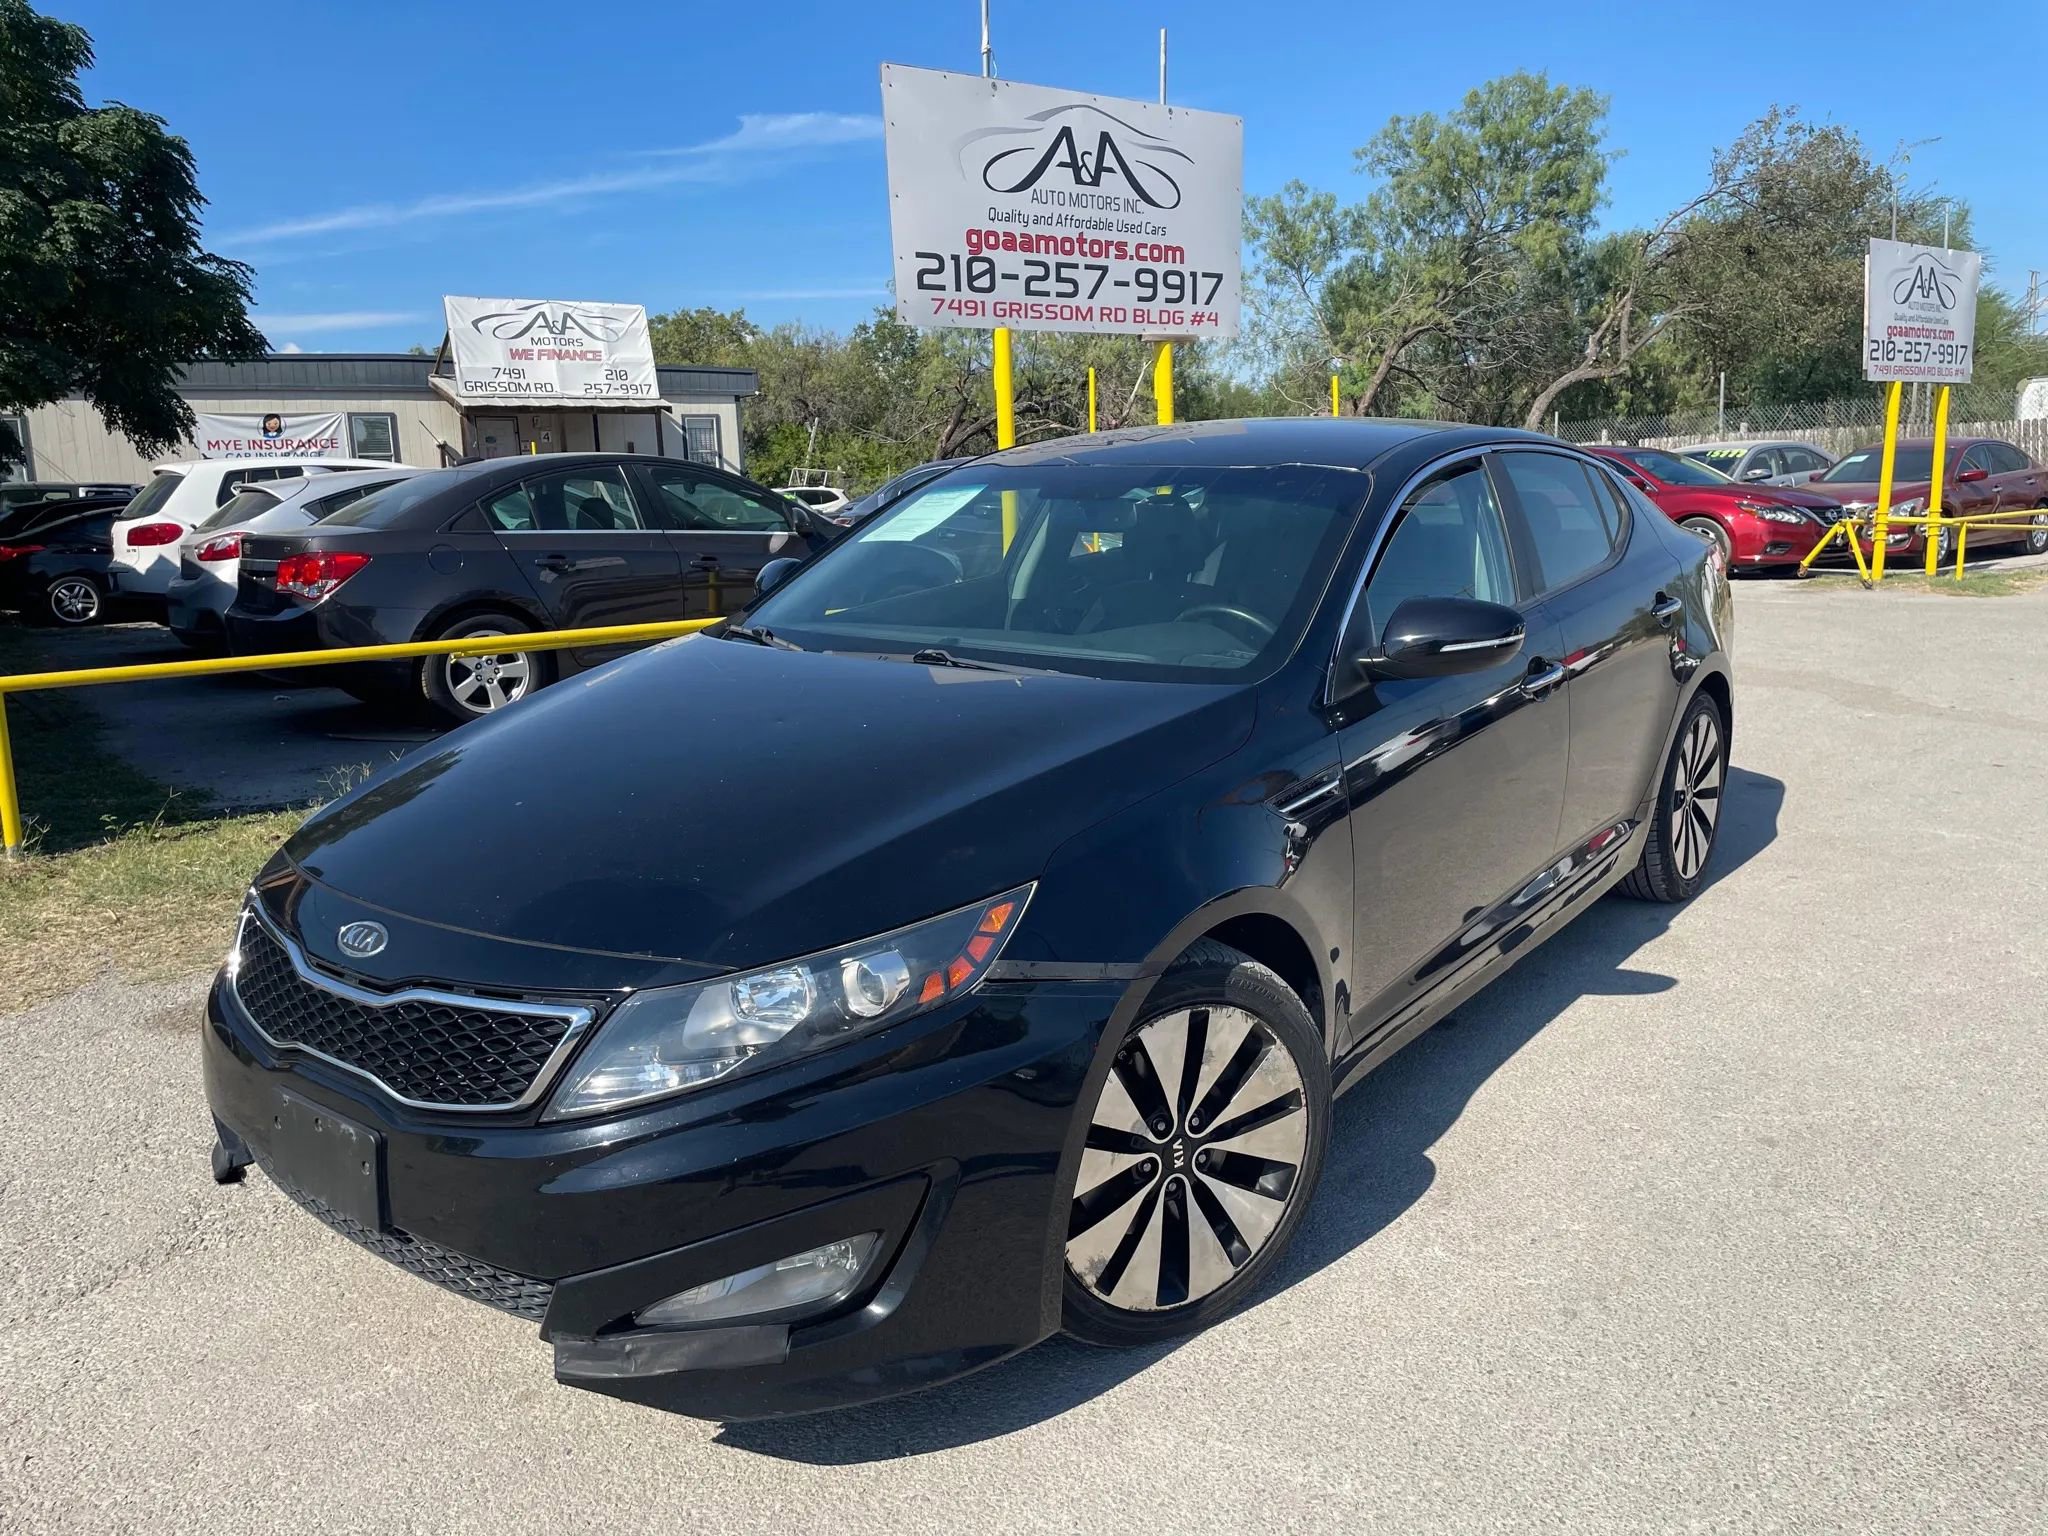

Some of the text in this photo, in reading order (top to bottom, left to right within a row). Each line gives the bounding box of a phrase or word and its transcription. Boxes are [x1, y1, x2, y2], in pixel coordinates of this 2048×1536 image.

[1031, 188, 1145, 215] AUTO MOTORS INC.
[988, 207, 1167, 237] Quality and Affordable Used Cars
[966, 228, 1185, 264] goaamotors.com
[915, 251, 1223, 306] 210-257-9917
[931, 298, 1219, 327] 7491 GRISSOM RD BLDG #4
[1887, 324, 1954, 341] goaamotors.com
[530, 336, 584, 347] MOTORS
[509, 348, 603, 362] WE FINANCE
[1870, 339, 1968, 365] 210-257-9917
[491, 367, 526, 379] 7491
[604, 369, 629, 381] 210
[1873, 365, 1892, 375] 7491
[1893, 365, 1926, 376] GRISSOM
[1927, 367, 1936, 376] RD
[1937, 367, 1953, 377] BLDG
[464, 380, 558, 393] GRISSOM RD.
[584, 383, 652, 395] 257-9917
[207, 438, 339, 451] MYE INSURANCE
[543, 432, 550, 442] 4
[343, 925, 379, 951] KIA
[1172, 1138, 1184, 1168] KIA
